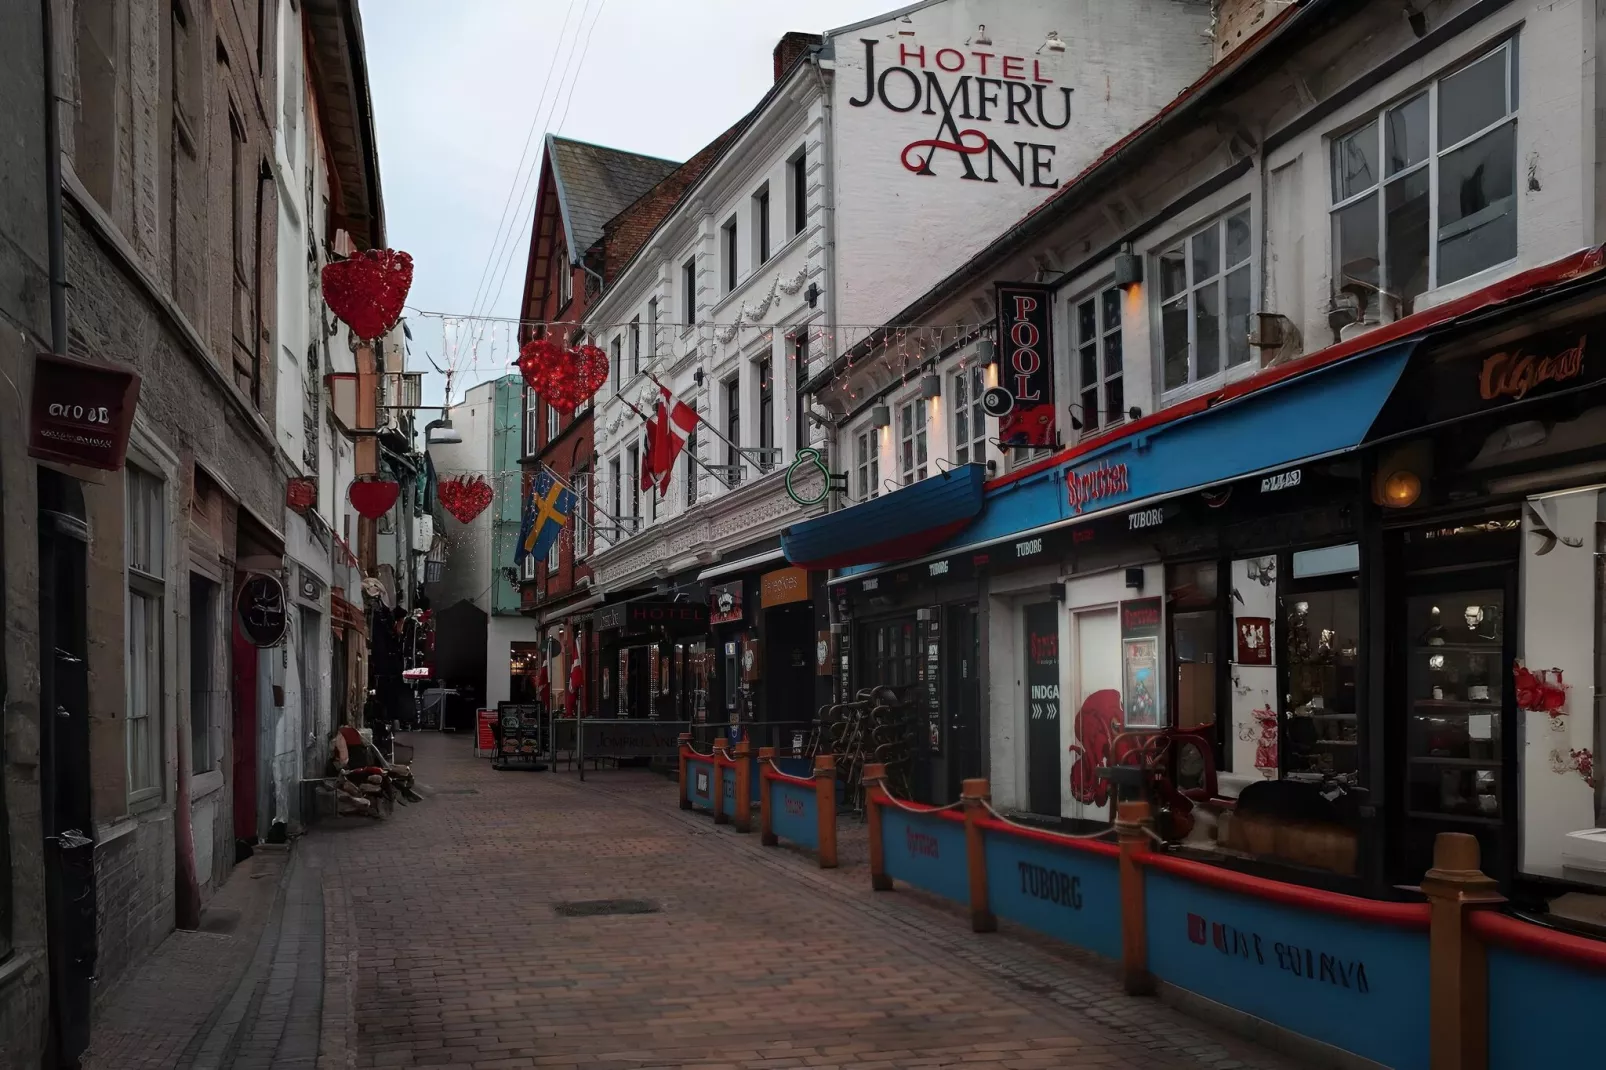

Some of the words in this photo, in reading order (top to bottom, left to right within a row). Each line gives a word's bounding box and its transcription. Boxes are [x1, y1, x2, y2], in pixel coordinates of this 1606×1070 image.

[849, 38, 1074, 130] JOMFRU
[899, 43, 1054, 84] HOTEL
[900, 108, 1060, 189] ANE
[1011, 295, 1042, 401] POOL
[987, 394, 997, 406] 8
[1065, 461, 1130, 513] Sprutten
[1128, 508, 1164, 530] TUBORG
[1016, 538, 1042, 557] TUBORG
[632, 607, 705, 621] HOTEL
[1018, 862, 1083, 911] TUBORG
